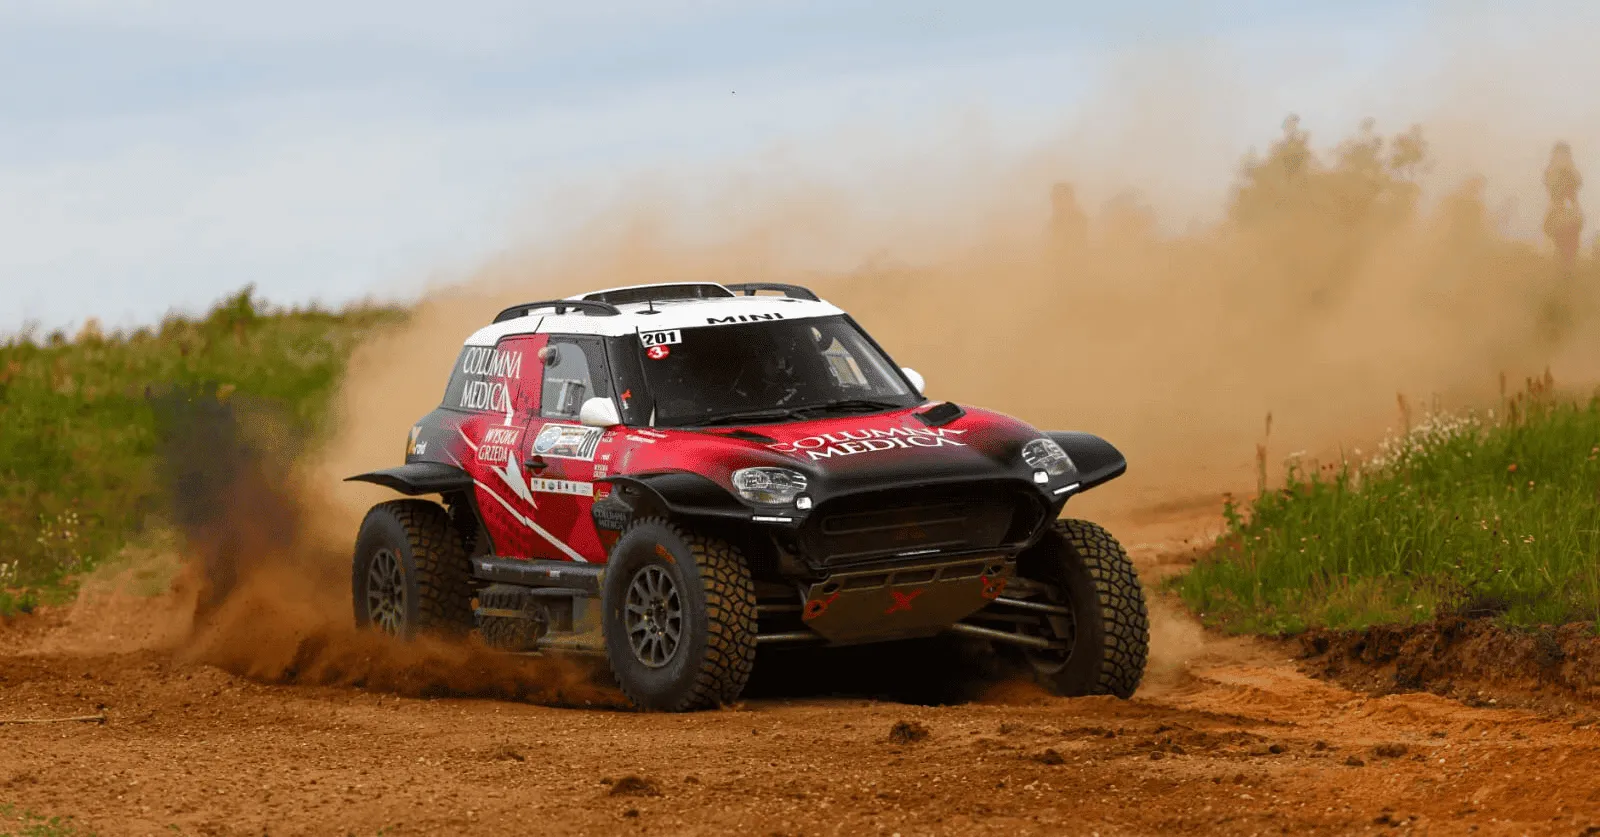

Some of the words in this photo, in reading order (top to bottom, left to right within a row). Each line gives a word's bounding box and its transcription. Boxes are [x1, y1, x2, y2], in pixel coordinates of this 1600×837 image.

[707, 313, 784, 324] MINI
[643, 332, 677, 346] 201
[463, 347, 523, 379] COLUMNA
[460, 380, 509, 412] MEDICA
[485, 428, 519, 445] WYSOKA
[577, 429, 603, 459] 201
[766, 426, 968, 453] COLUMNA
[806, 435, 968, 462] MEDICA
